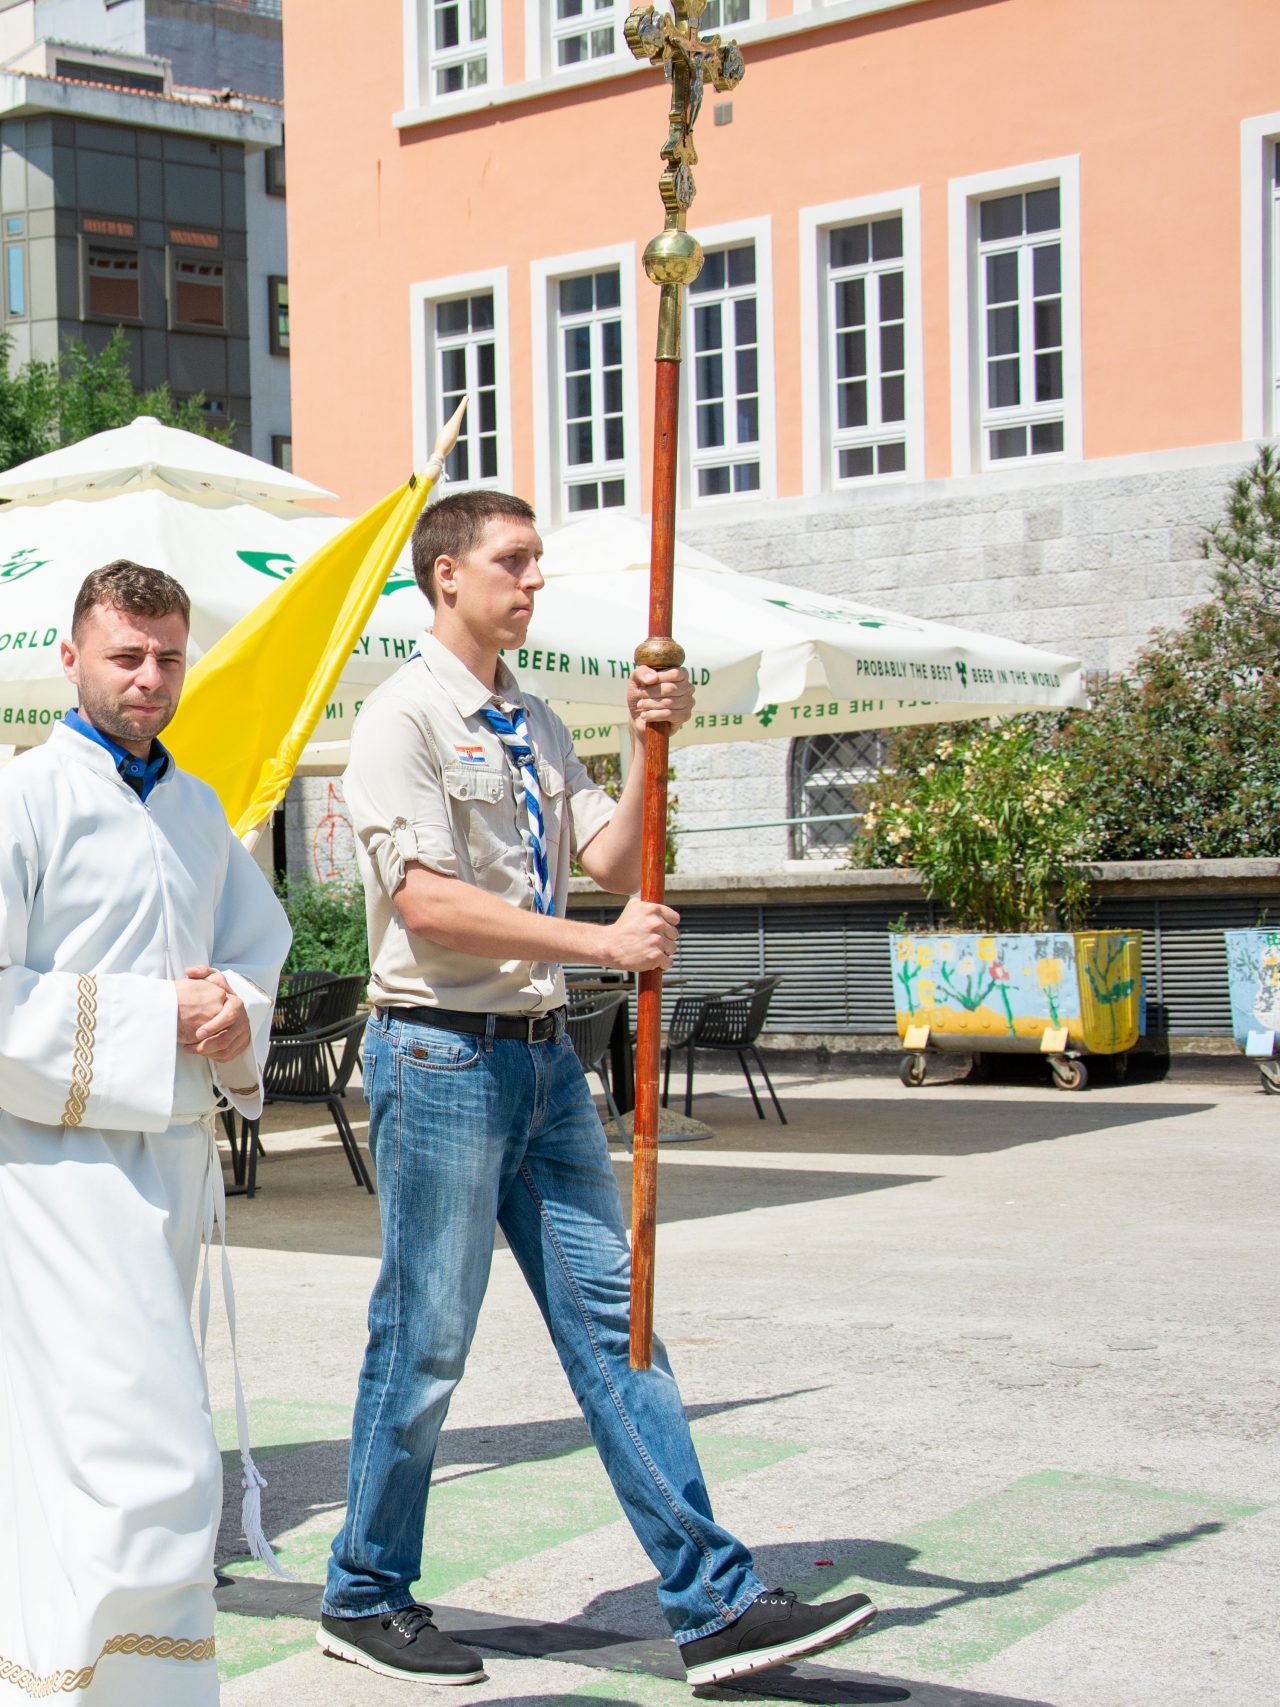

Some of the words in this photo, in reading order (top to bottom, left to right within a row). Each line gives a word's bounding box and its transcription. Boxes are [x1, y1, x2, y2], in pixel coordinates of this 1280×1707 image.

[517, 648, 571, 673] BEER
[580, 655, 600, 676] IN
[607, 659, 638, 679] TH
[856, 659, 907, 677] PROBABLY
[910, 662, 928, 679] THE
[931, 664, 953, 681] BEST
[971, 667, 995, 684] BEER
[997, 669, 1008, 684] IN
[1009, 669, 1029, 686] THE
[1030, 671, 1061, 688] WORLD
